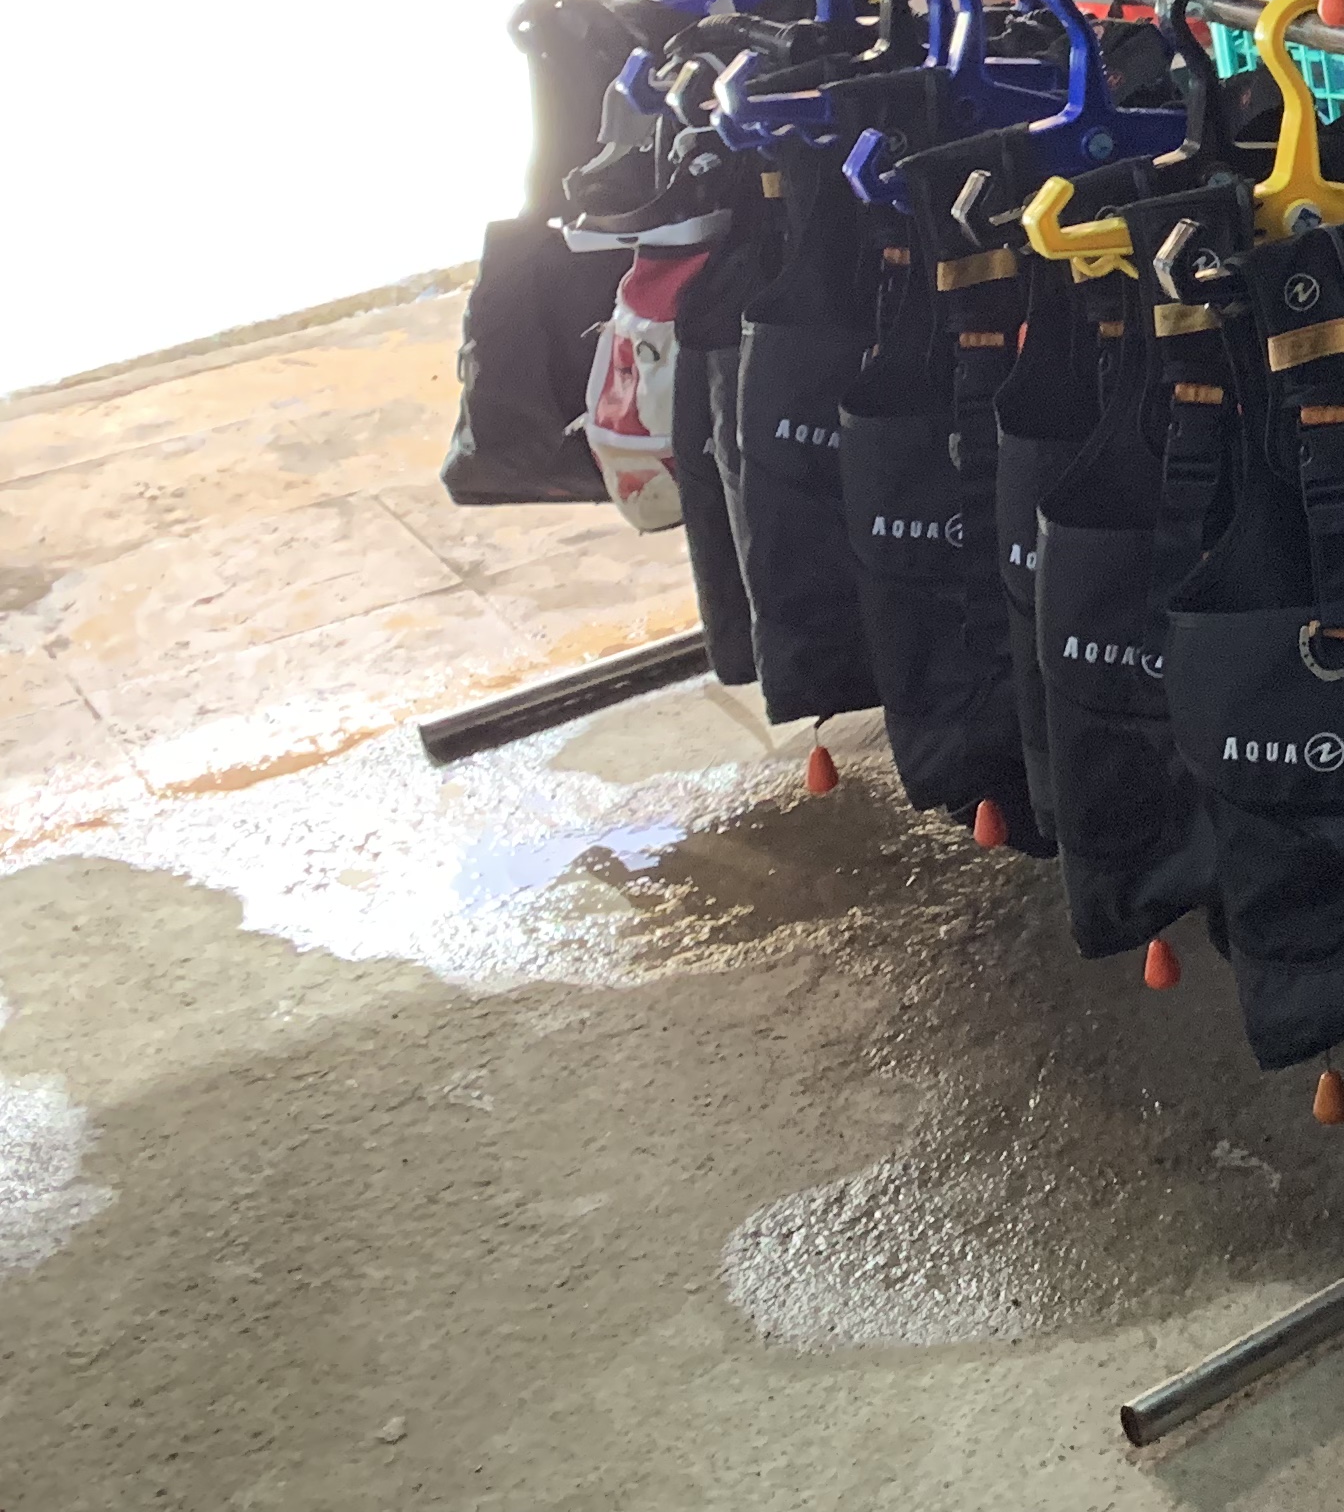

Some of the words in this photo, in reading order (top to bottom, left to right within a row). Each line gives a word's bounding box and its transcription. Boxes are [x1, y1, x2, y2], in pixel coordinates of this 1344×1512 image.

[775, 419, 840, 449] AQUA
[872, 516, 939, 539] AQUA
[1009, 543, 1037, 571] AQ
[1063, 636, 1135, 666] AQUA
[1223, 737, 1298, 764] AQUA
